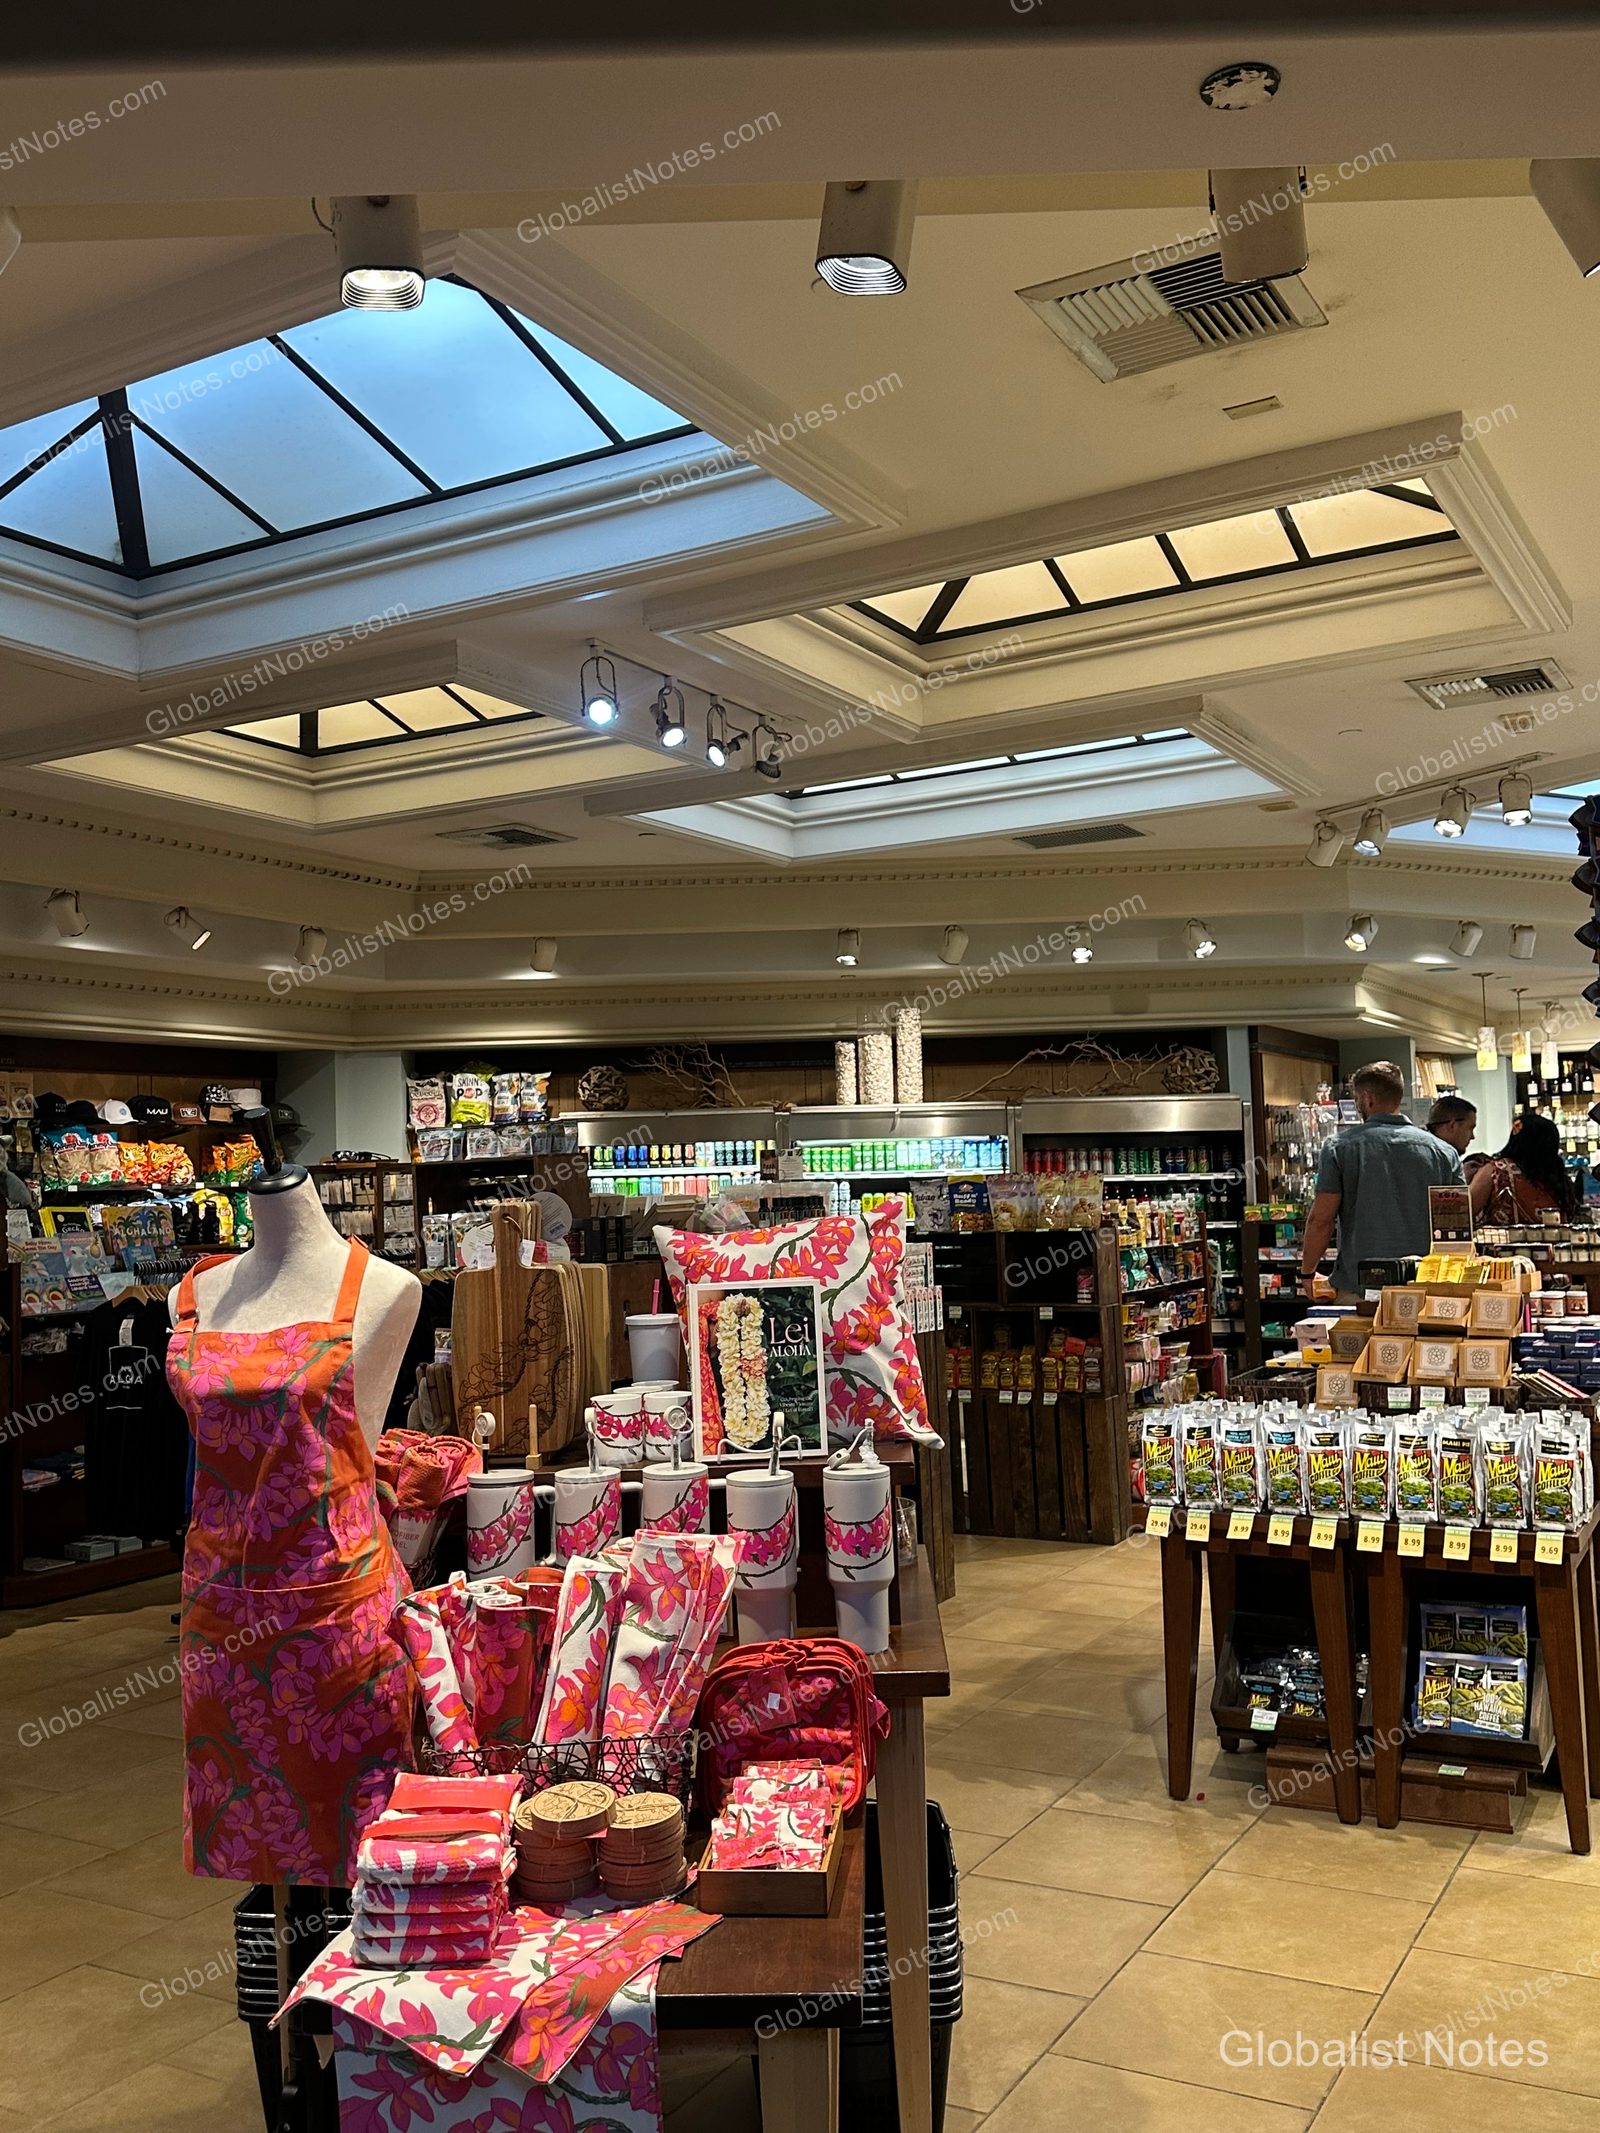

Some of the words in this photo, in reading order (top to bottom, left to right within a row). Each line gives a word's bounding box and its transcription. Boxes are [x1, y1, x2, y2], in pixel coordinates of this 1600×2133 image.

[769, 1317, 810, 1344] Lei
[770, 1344, 812, 1358] ALOHA
[1145, 1438, 1171, 1461] Maui
[1186, 1443, 1210, 1465] Maui
[1223, 1448, 1251, 1468] Maui
[1268, 1446, 1297, 1468] Maui
[1310, 1453, 1338, 1475] Maui
[1355, 1452, 1384, 1473] Maui
[1399, 1451, 1428, 1473] Maui
[1443, 1457, 1471, 1478] Maui
[1488, 1456, 1516, 1480] Maui
[1538, 1459, 1568, 1483] Maui
[1151, 1520, 1167, 1528] 29.49
[1273, 1529, 1290, 1538] 8.99
[1316, 1532, 1333, 1541] 8.99
[1364, 1536, 1380, 1544] 8.99
[1404, 1538, 1421, 1546] 8.99
[1449, 1541, 1466, 1550] 8.99
[1495, 1545, 1513, 1553] 8.99
[1541, 1546, 1558, 1555] 9.69
[1474, 1701, 1508, 1716] HAWAIIAN
[1479, 1711, 1501, 1724] COFFEE
